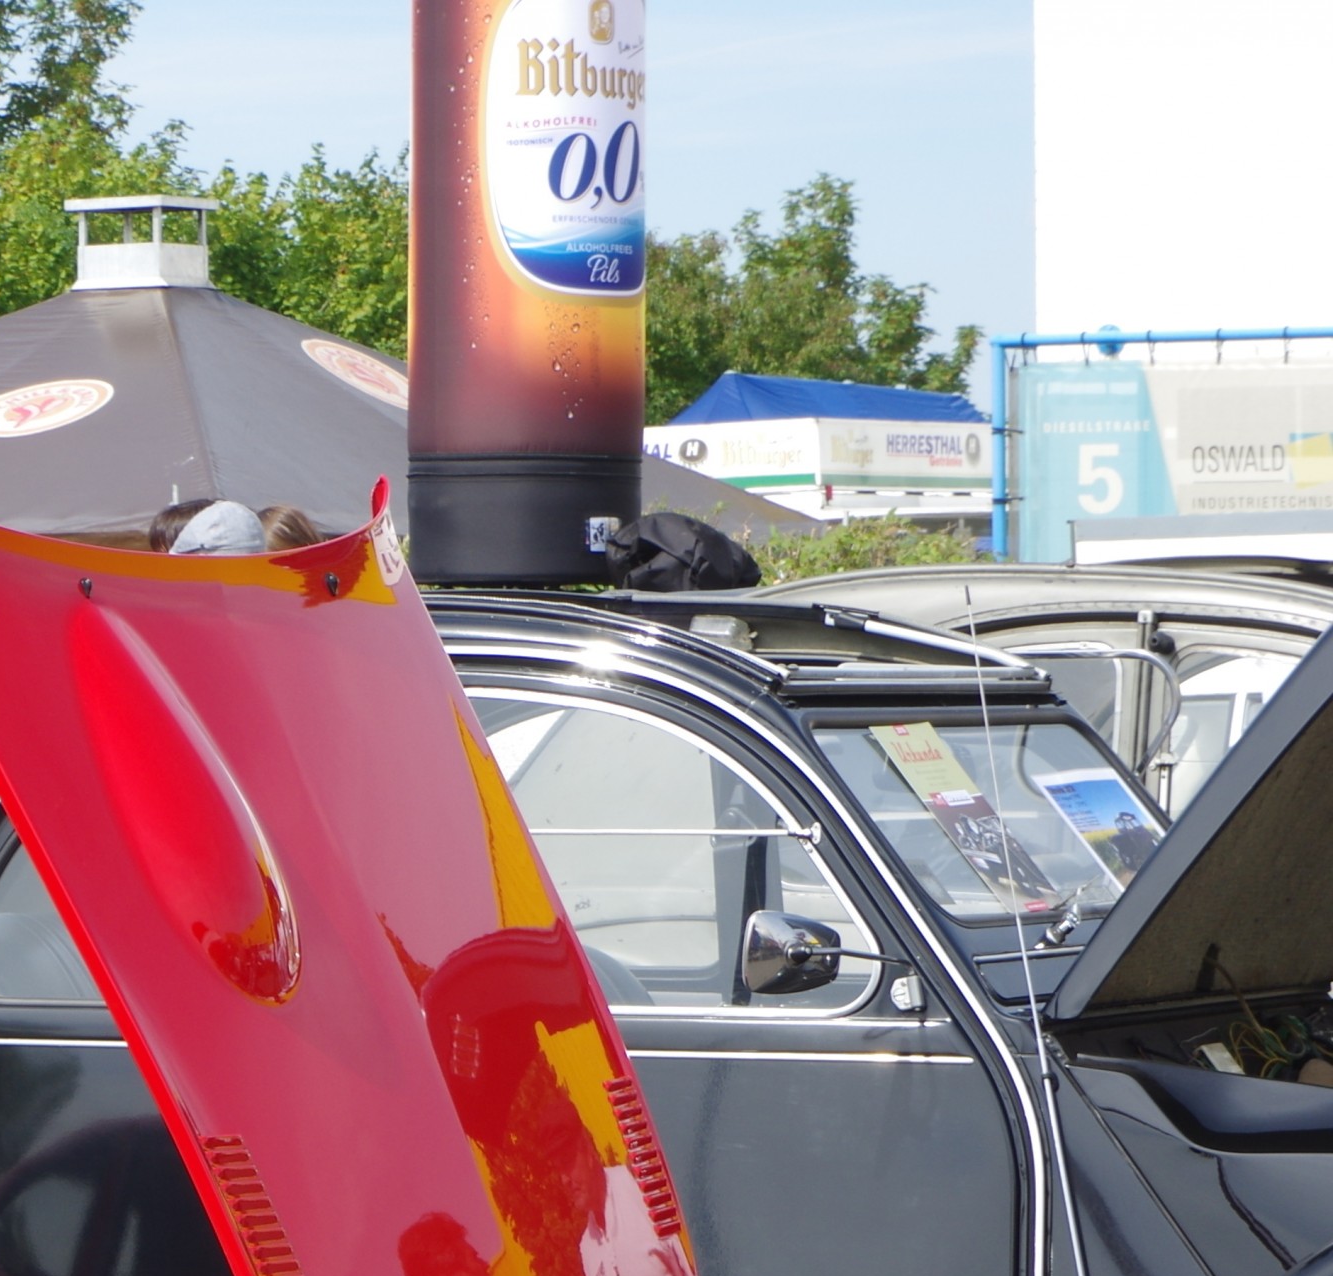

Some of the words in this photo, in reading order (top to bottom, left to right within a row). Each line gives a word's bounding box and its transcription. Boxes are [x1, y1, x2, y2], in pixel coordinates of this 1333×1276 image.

[515, 37, 645, 110] Bitburge
[506, 116, 598, 129] ALKOHOLFREI
[548, 120, 640, 209] 0,0
[552, 215, 617, 225] ERFRISCHENDER
[566, 241, 633, 255] ALKOHOLFREIES
[587, 253, 620, 283] Pils
[886, 434, 963, 454] HERRESTHAL
[1192, 444, 1285, 473] OSWALD
[1077, 443, 1124, 514] 5
